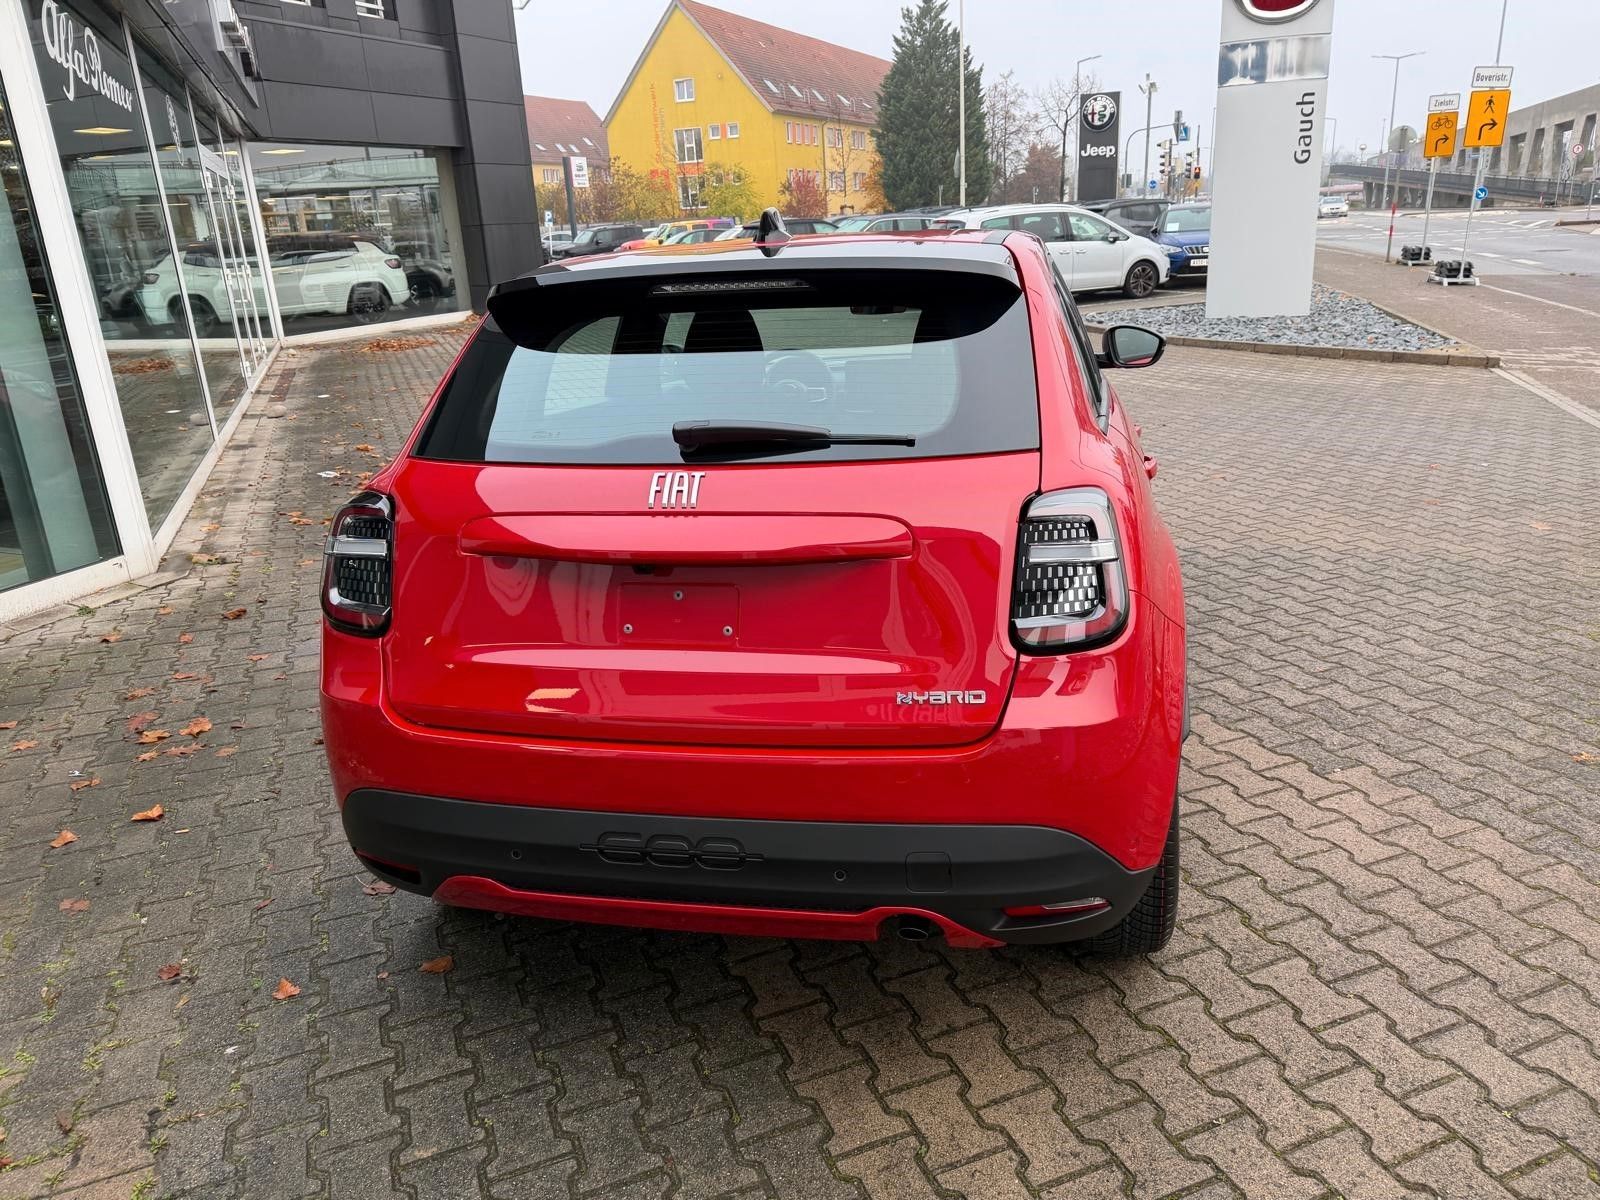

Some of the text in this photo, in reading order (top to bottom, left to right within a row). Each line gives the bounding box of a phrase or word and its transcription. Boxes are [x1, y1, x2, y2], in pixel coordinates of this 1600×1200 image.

[42, 0, 90, 102] Alfa
[84, 26, 132, 112] Romeo
[1475, 72, 1508, 82] Boveristr.
[1434, 99, 1455, 107] Zielstr.
[1293, 92, 1315, 164] Gauch
[648, 472, 706, 509] FIAT
[896, 690, 987, 705] HYBRID
